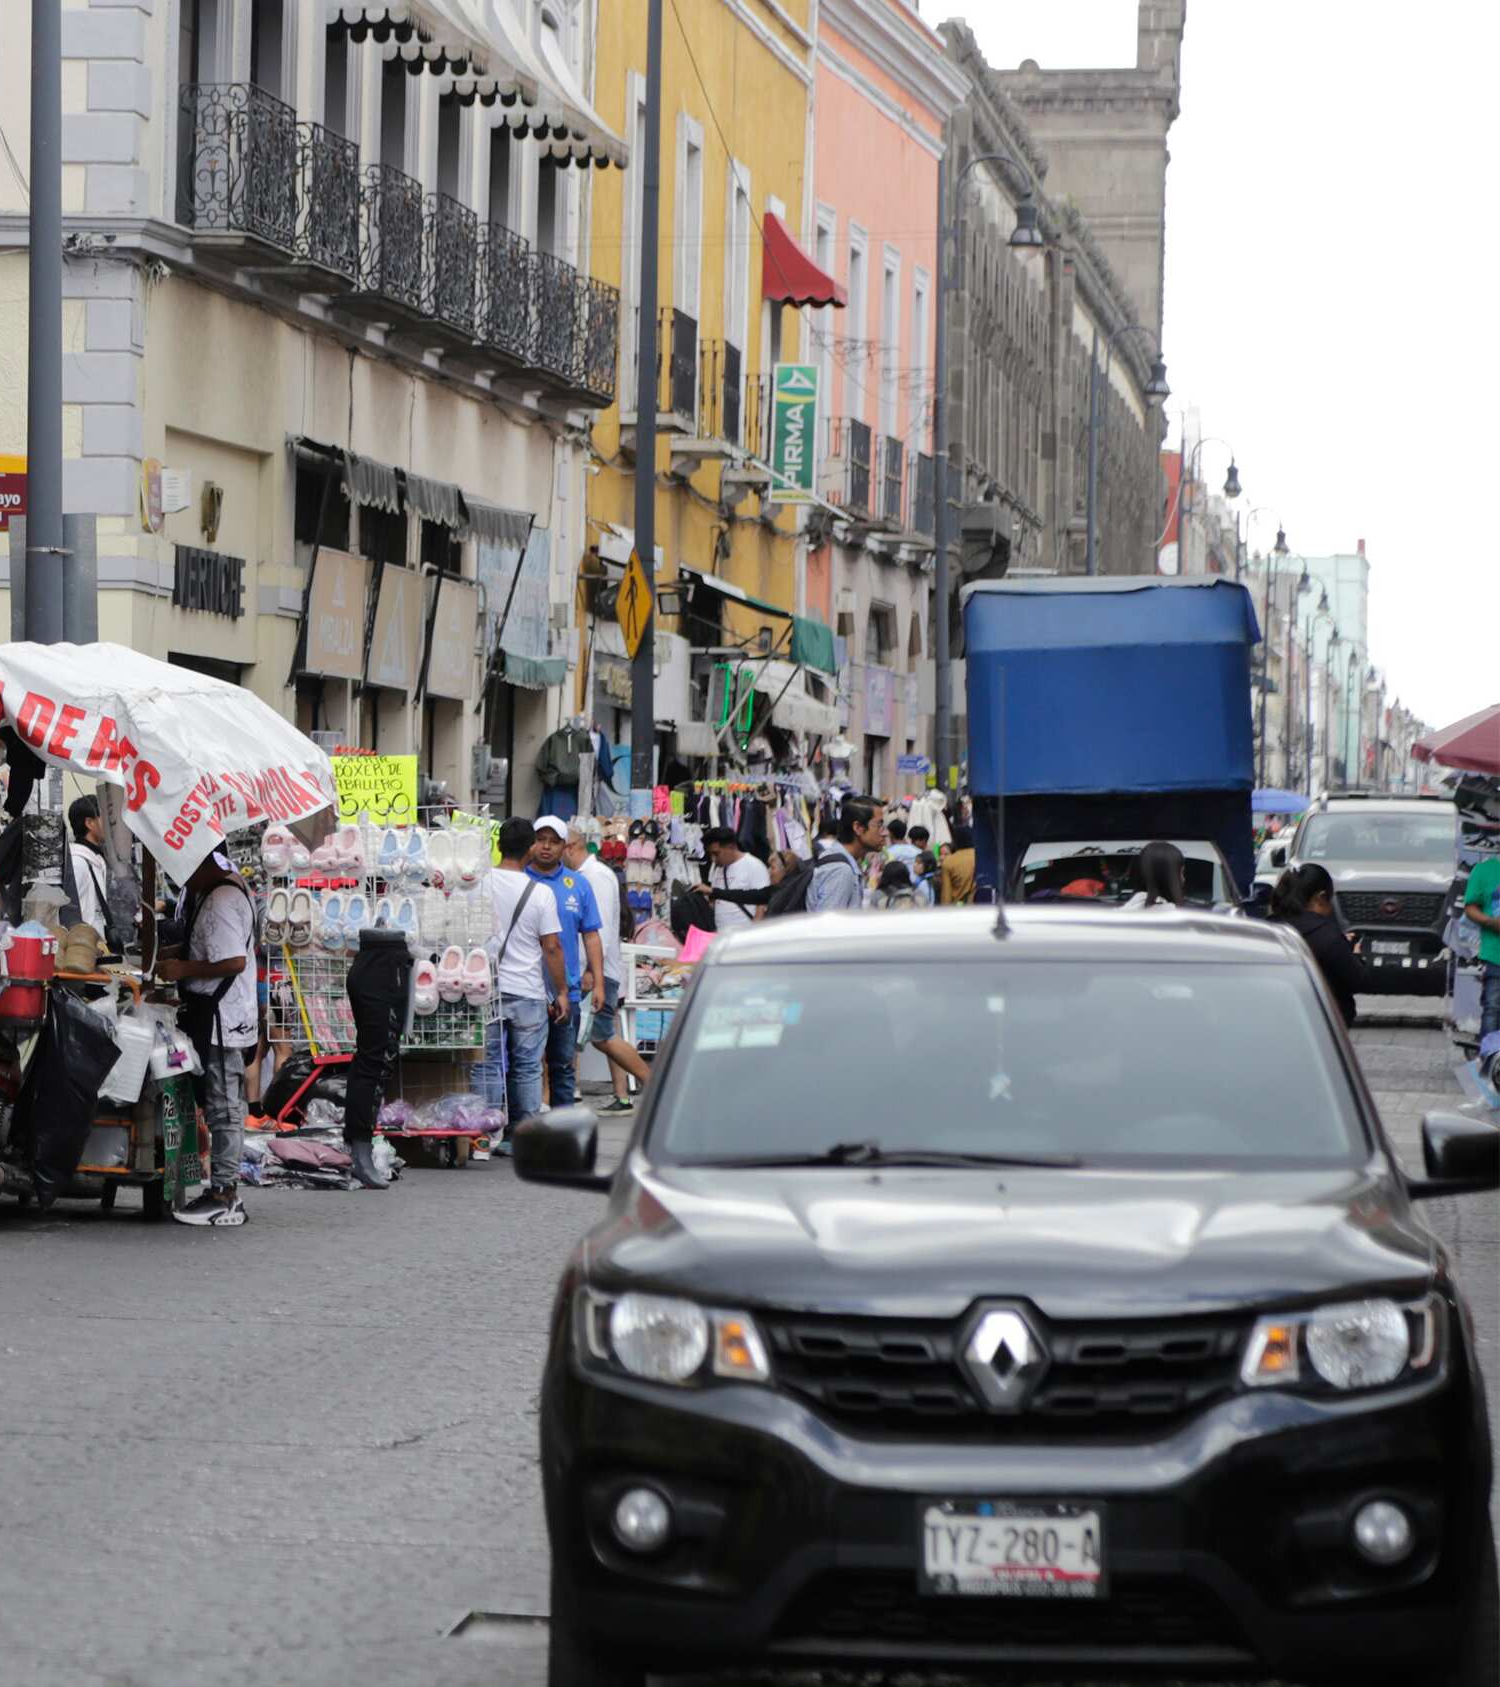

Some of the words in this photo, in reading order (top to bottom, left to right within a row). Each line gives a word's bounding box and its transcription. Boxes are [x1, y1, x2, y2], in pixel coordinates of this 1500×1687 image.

[782, 403, 804, 489] PIRMA
[16, 691, 87, 761] DE
[334, 763, 385, 777] BOXER
[388, 763, 403, 776] DE
[927, 1523, 1098, 1566] TYZ-280-A
